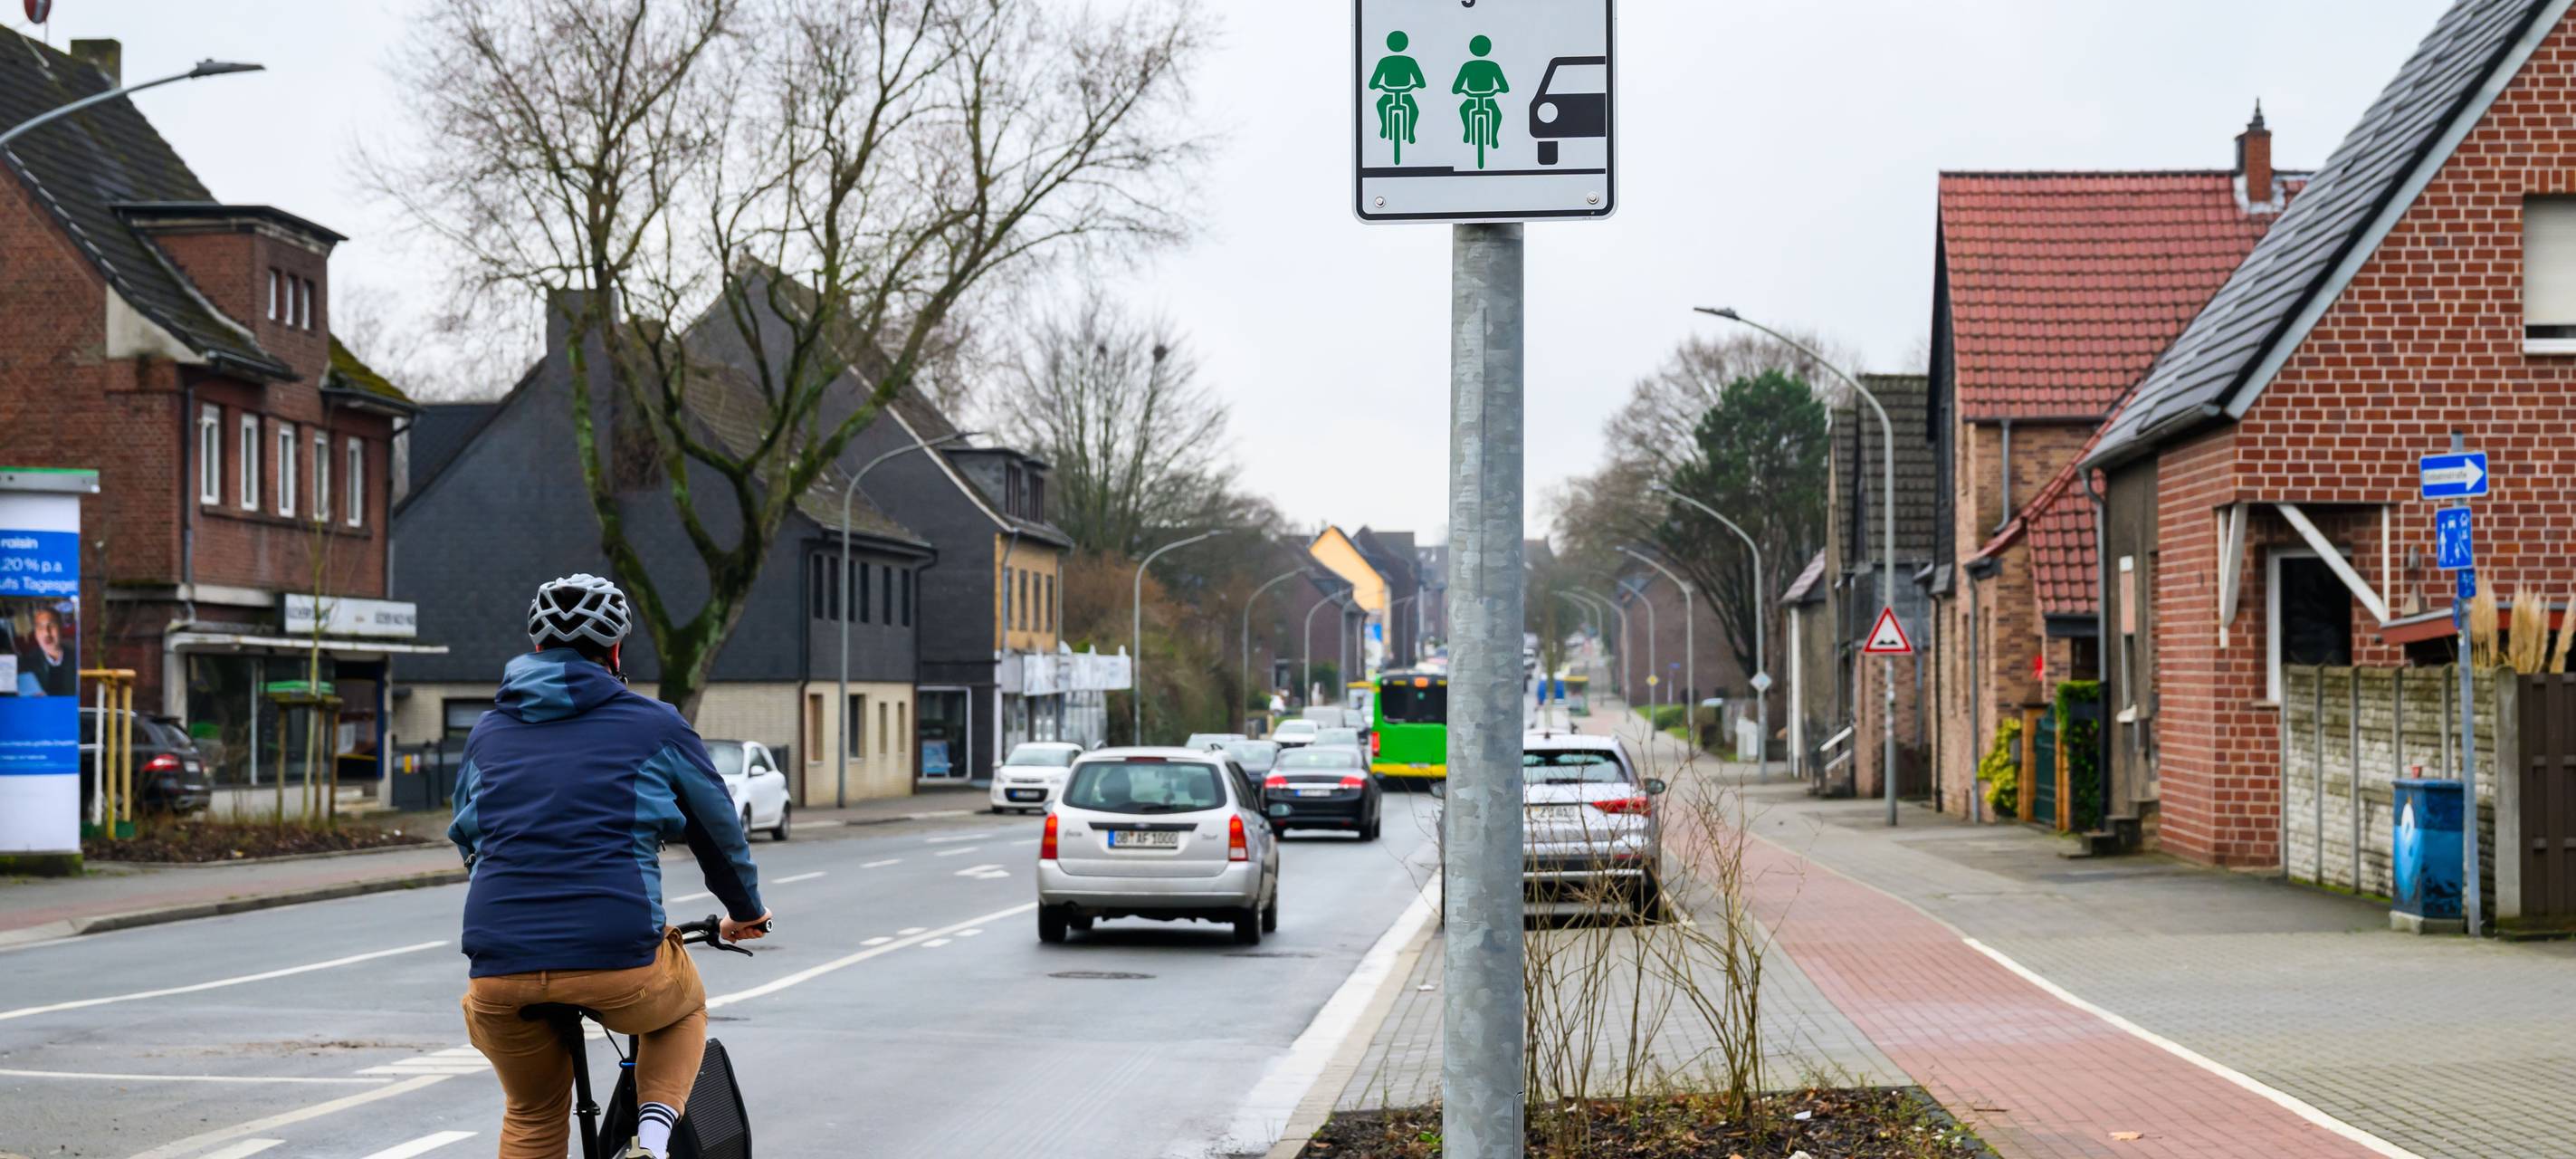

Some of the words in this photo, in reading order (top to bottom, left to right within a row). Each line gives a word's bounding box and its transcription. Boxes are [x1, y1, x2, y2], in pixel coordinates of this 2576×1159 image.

[1, 536, 39, 550] raisin
[1136, 831, 1148, 844] AF
[1152, 831, 1178, 845] 1000
